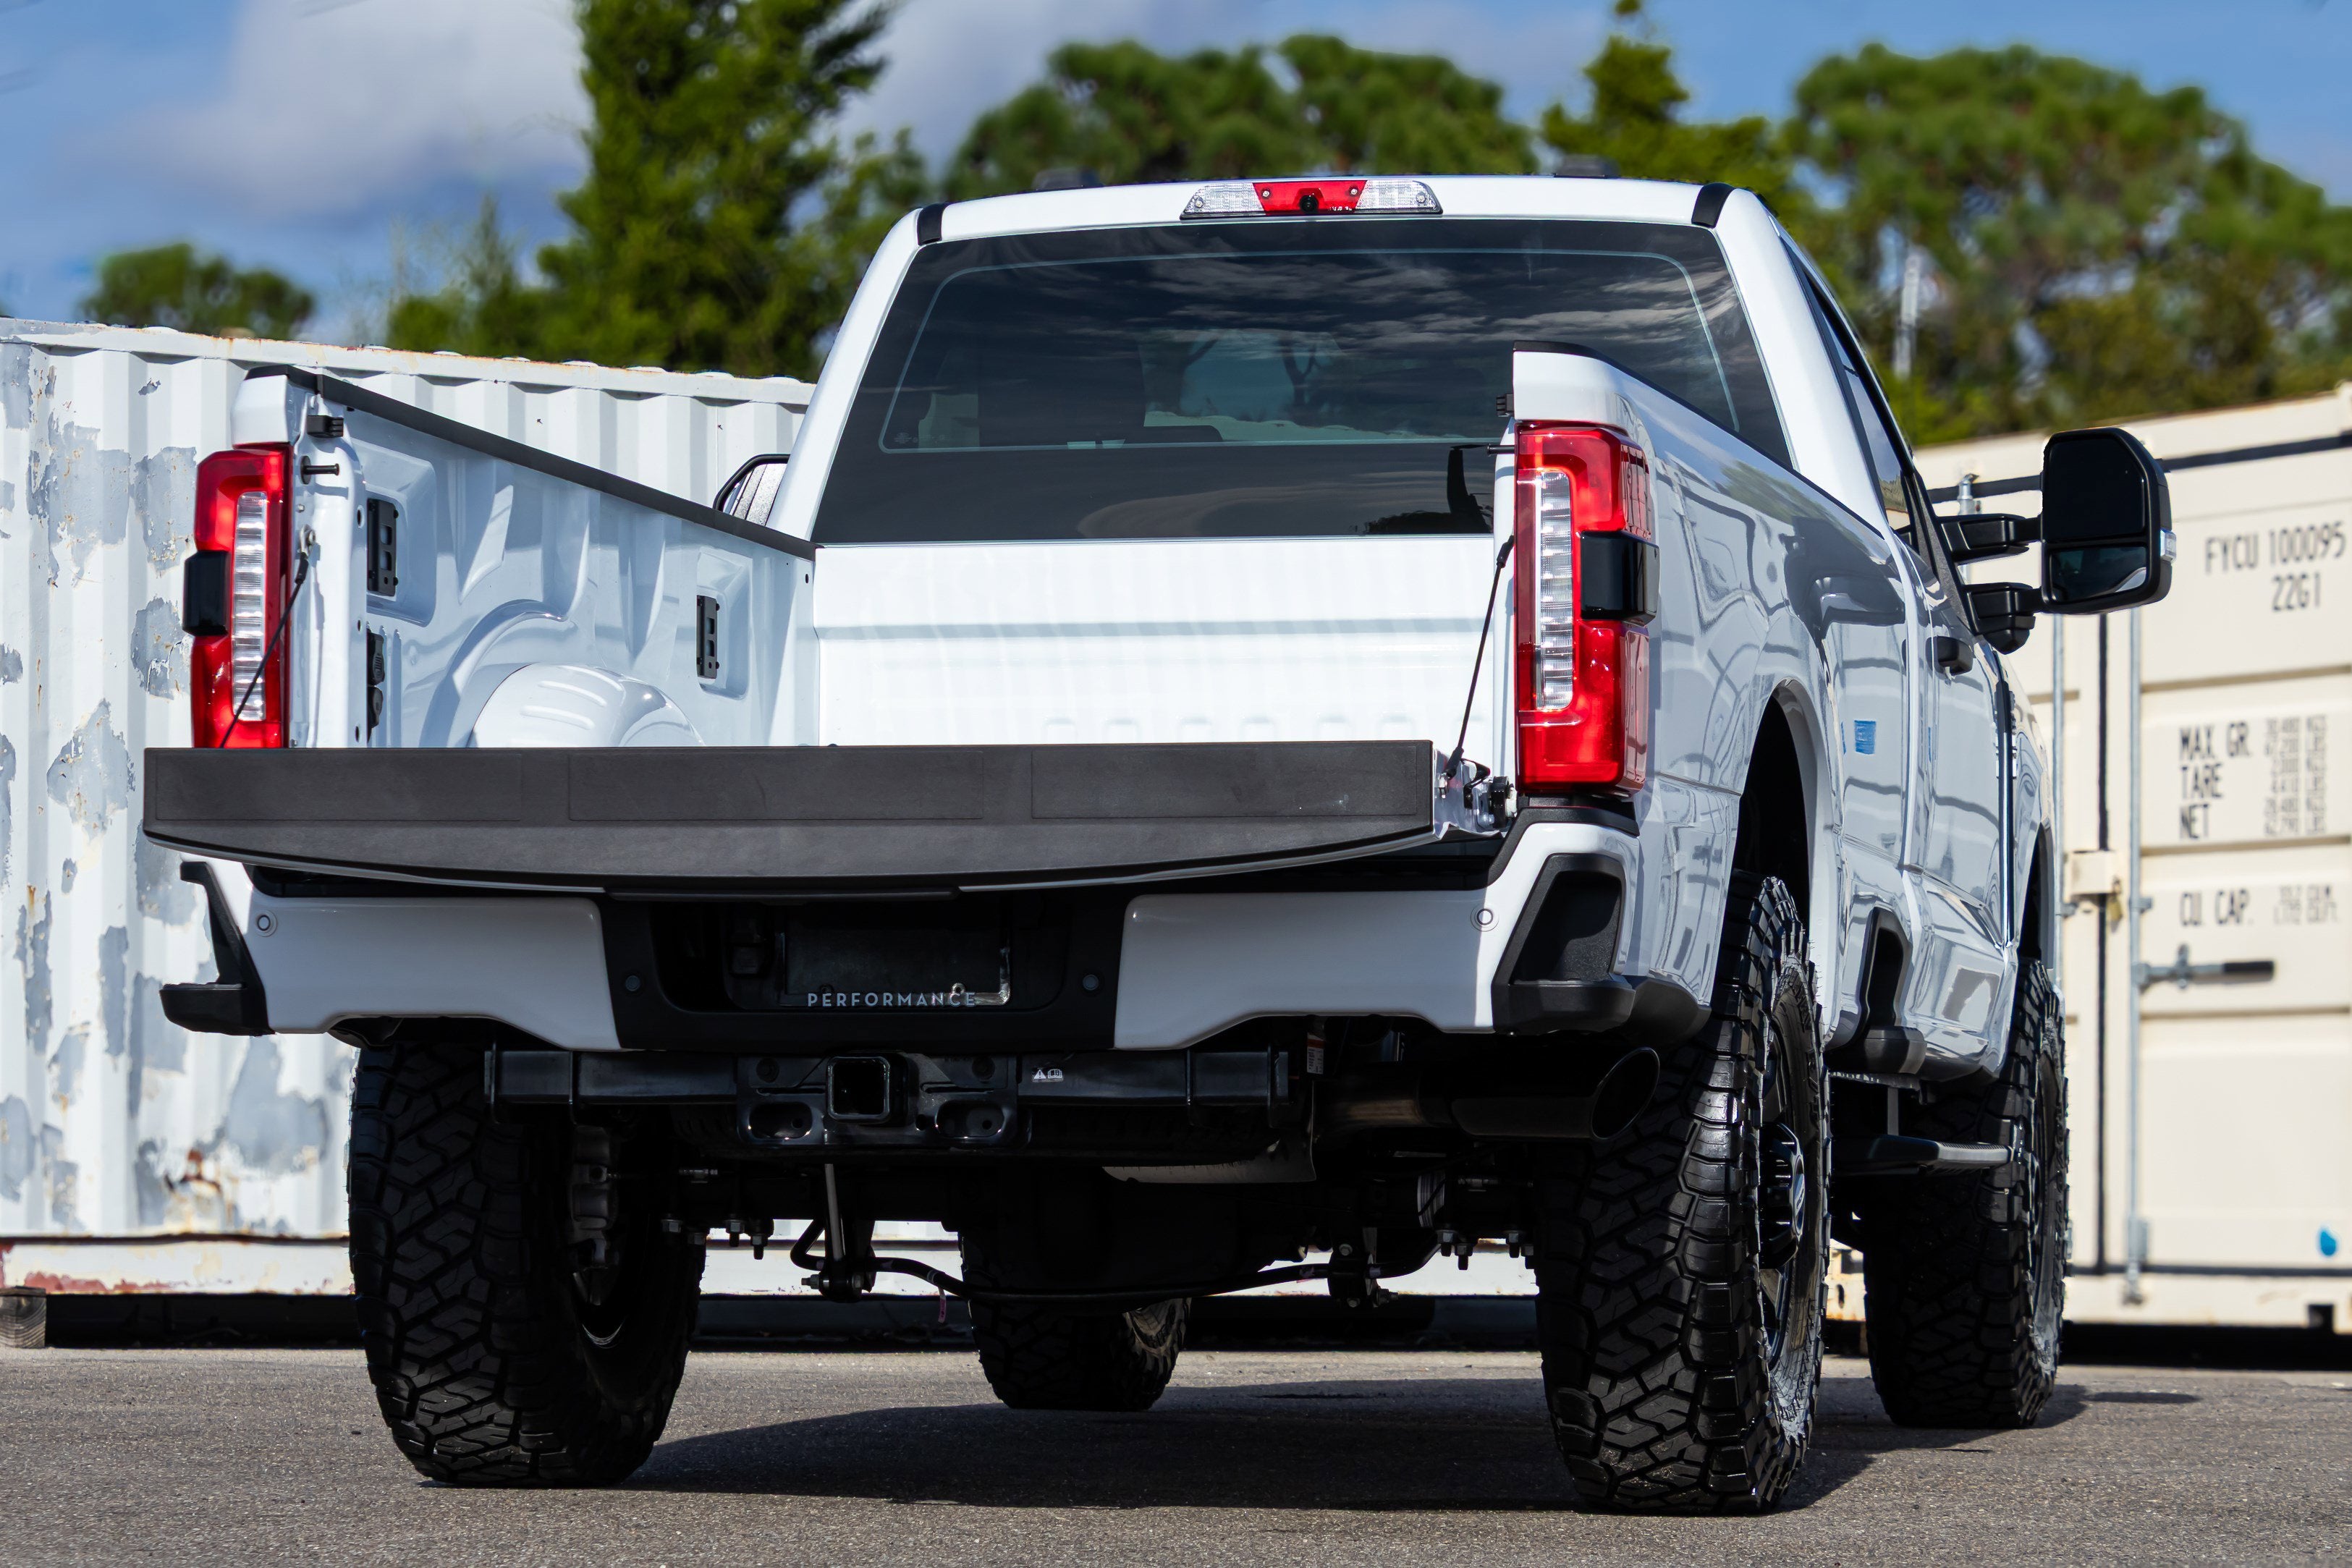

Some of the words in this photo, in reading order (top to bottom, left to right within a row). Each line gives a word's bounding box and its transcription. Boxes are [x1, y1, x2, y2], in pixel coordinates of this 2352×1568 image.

[2205, 533, 2259, 574] FYCU
[2269, 520, 2346, 566] 100095
[2272, 572, 2321, 611] 22G1
[2180, 762, 2223, 798] TARE
[2180, 803, 2209, 839] NET
[808, 992, 976, 1007] PERFORMANCE
